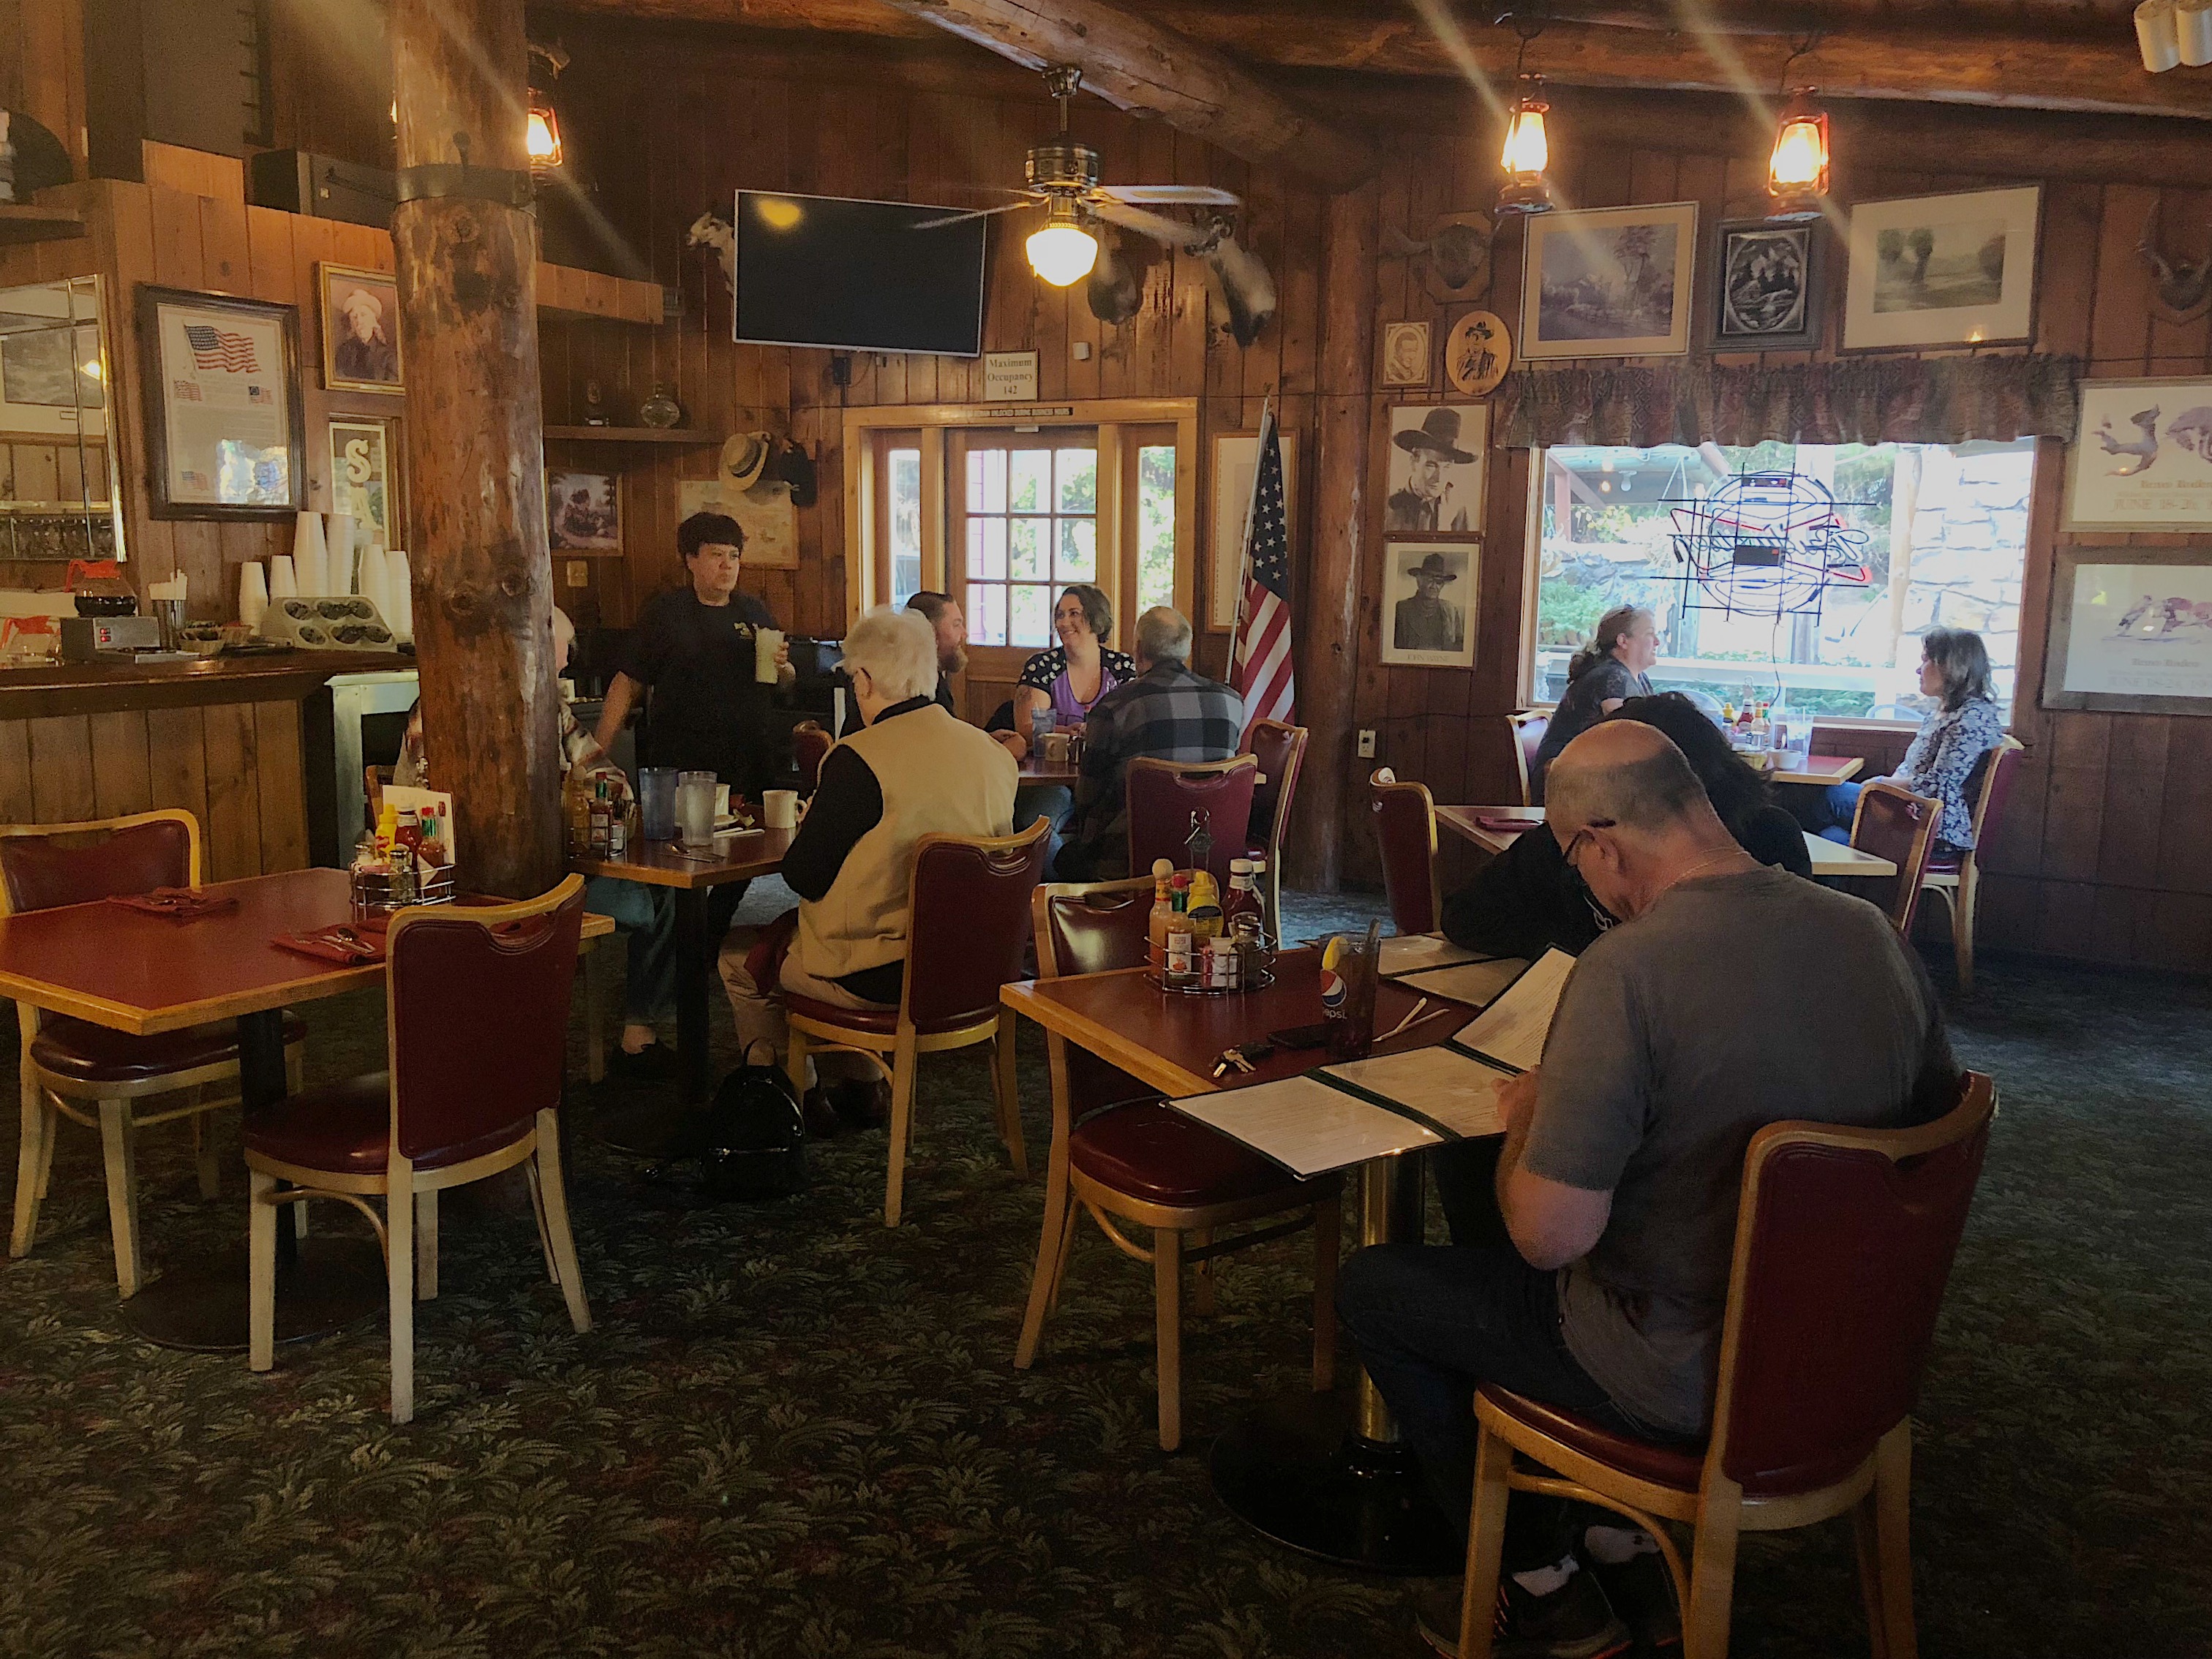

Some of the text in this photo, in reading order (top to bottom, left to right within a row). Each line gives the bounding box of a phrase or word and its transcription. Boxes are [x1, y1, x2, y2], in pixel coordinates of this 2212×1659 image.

[990, 358, 1032, 367] Maximum
[988, 373, 1033, 383] Occupancy
[1004, 385, 1017, 394] 142
